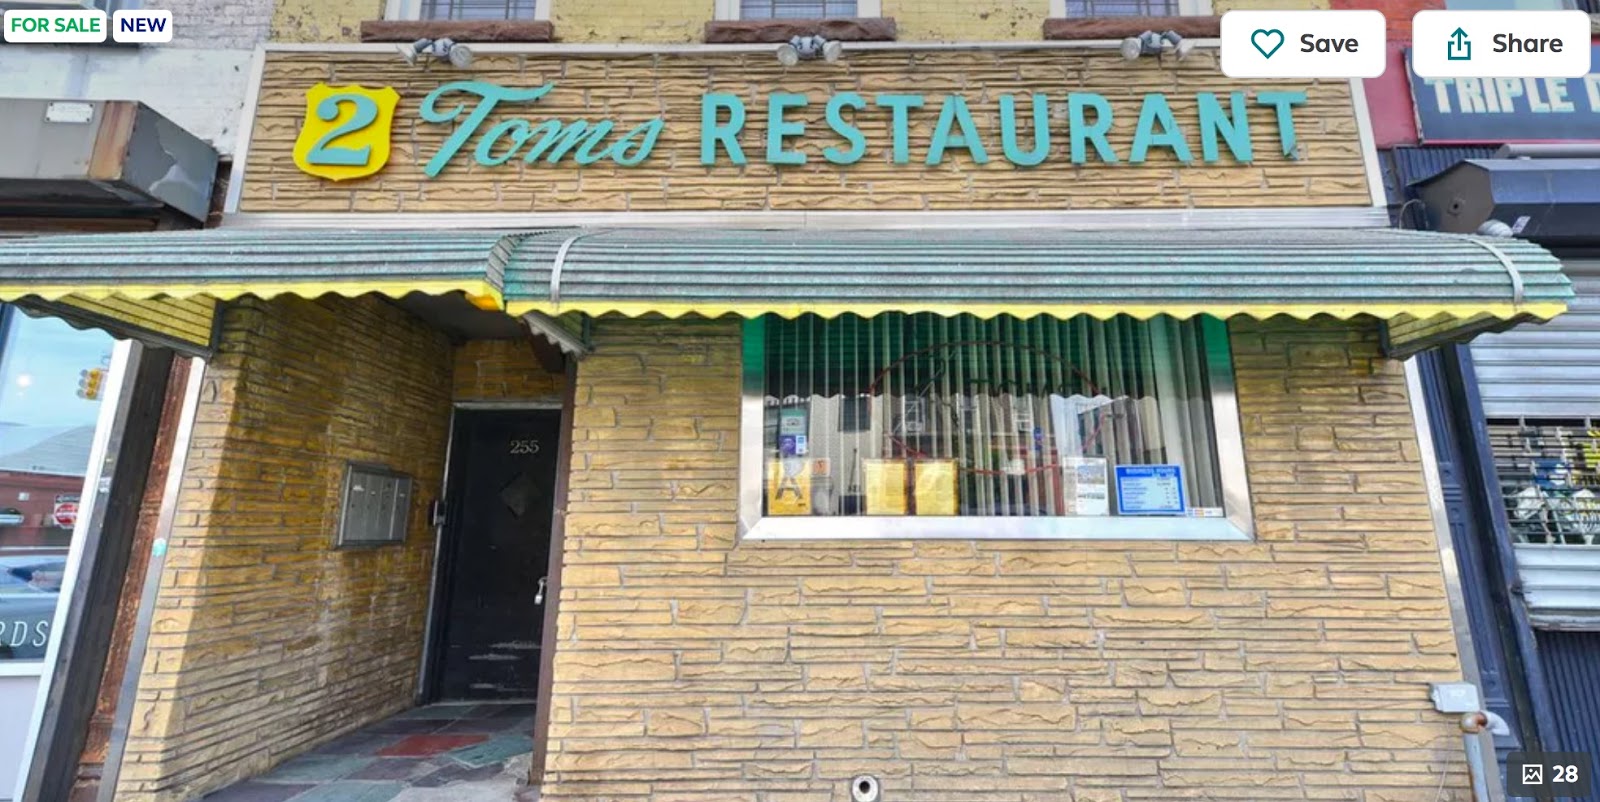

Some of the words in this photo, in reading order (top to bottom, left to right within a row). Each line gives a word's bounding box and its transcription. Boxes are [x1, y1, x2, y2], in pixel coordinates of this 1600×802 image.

[1424, 77, 1575, 114] TRIPLE
[306, 92, 379, 166] 2
[419, 81, 666, 179] Toms
[699, 92, 1308, 166] RESTAURANT
[510, 439, 540, 454] 255
